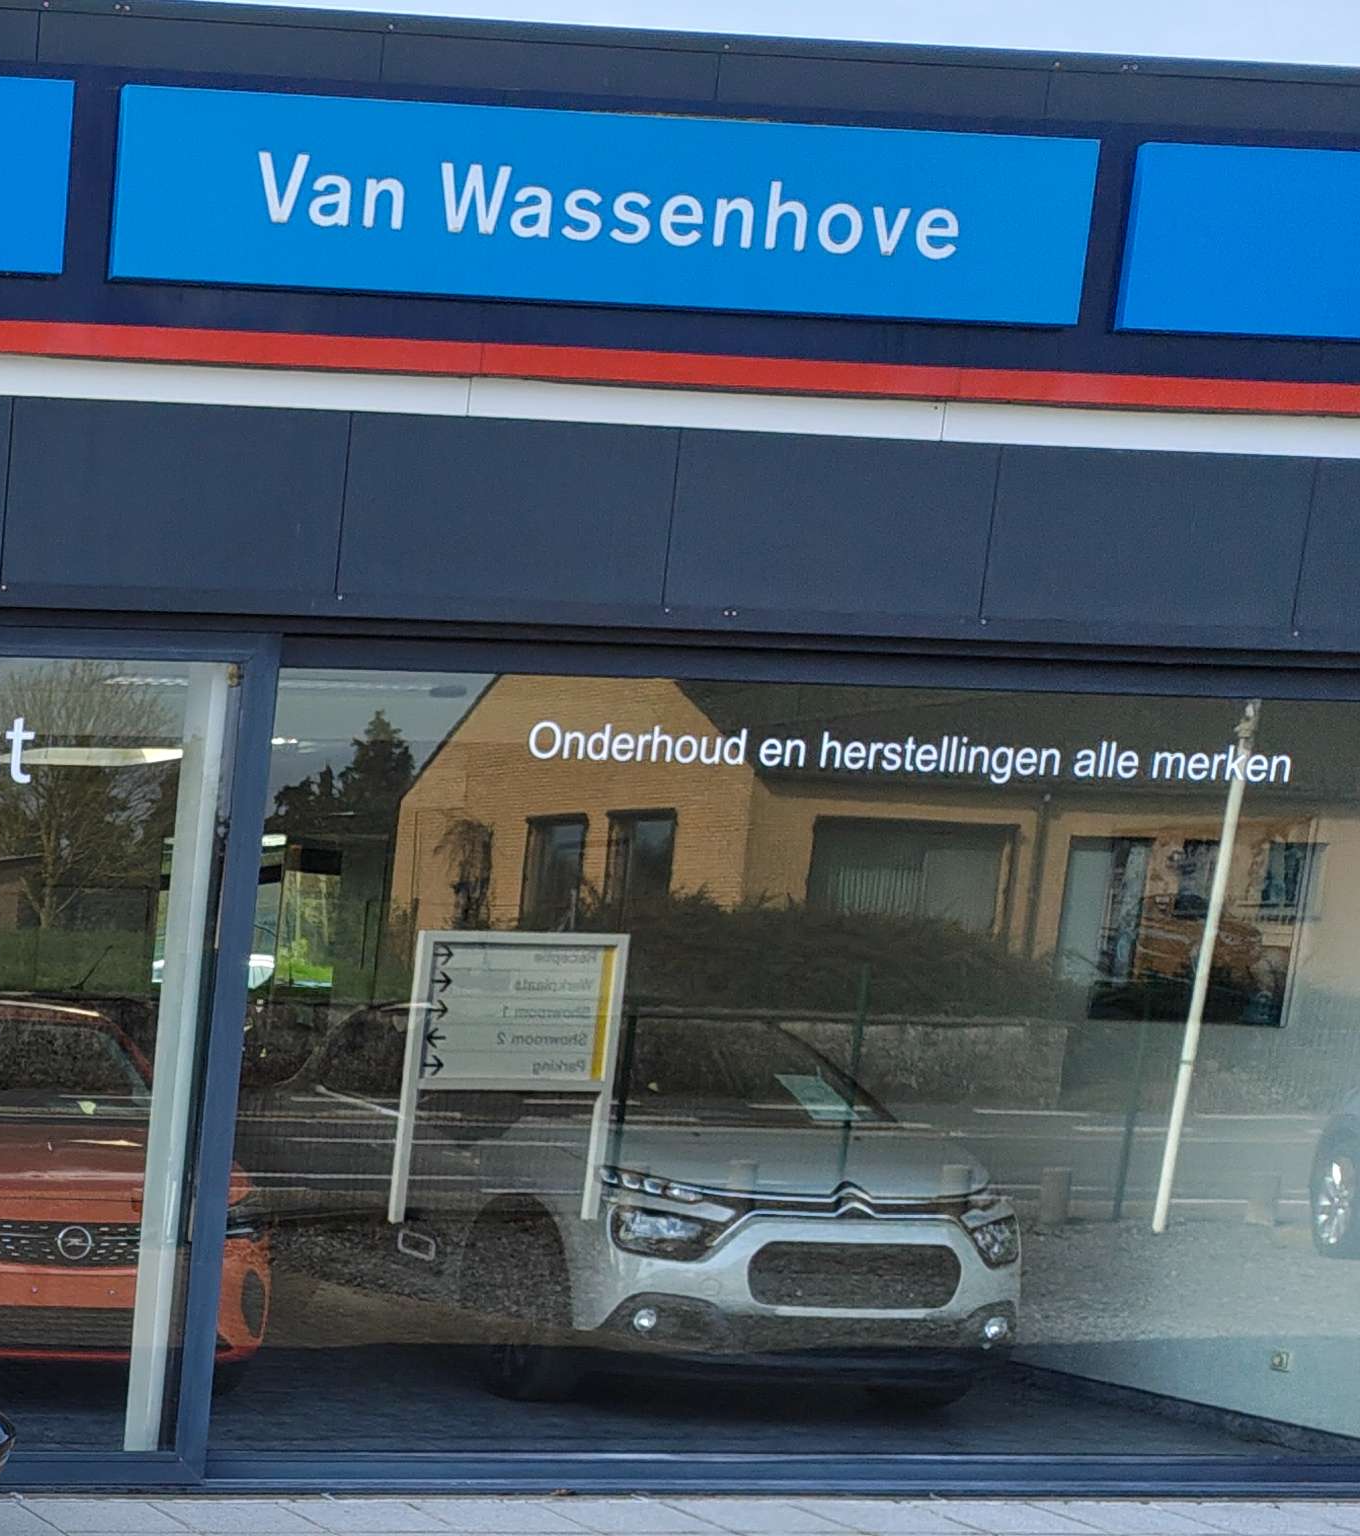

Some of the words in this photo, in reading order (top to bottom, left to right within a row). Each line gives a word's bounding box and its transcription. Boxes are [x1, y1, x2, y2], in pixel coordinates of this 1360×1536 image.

[258, 151, 406, 231] Van
[440, 161, 961, 260] Wassenhove
[527, 720, 747, 766] Onderhoud
[758, 737, 806, 768] en
[818, 732, 1062, 785] herstellingen
[1072, 741, 1140, 780] alle
[1149, 744, 1293, 785] merken
